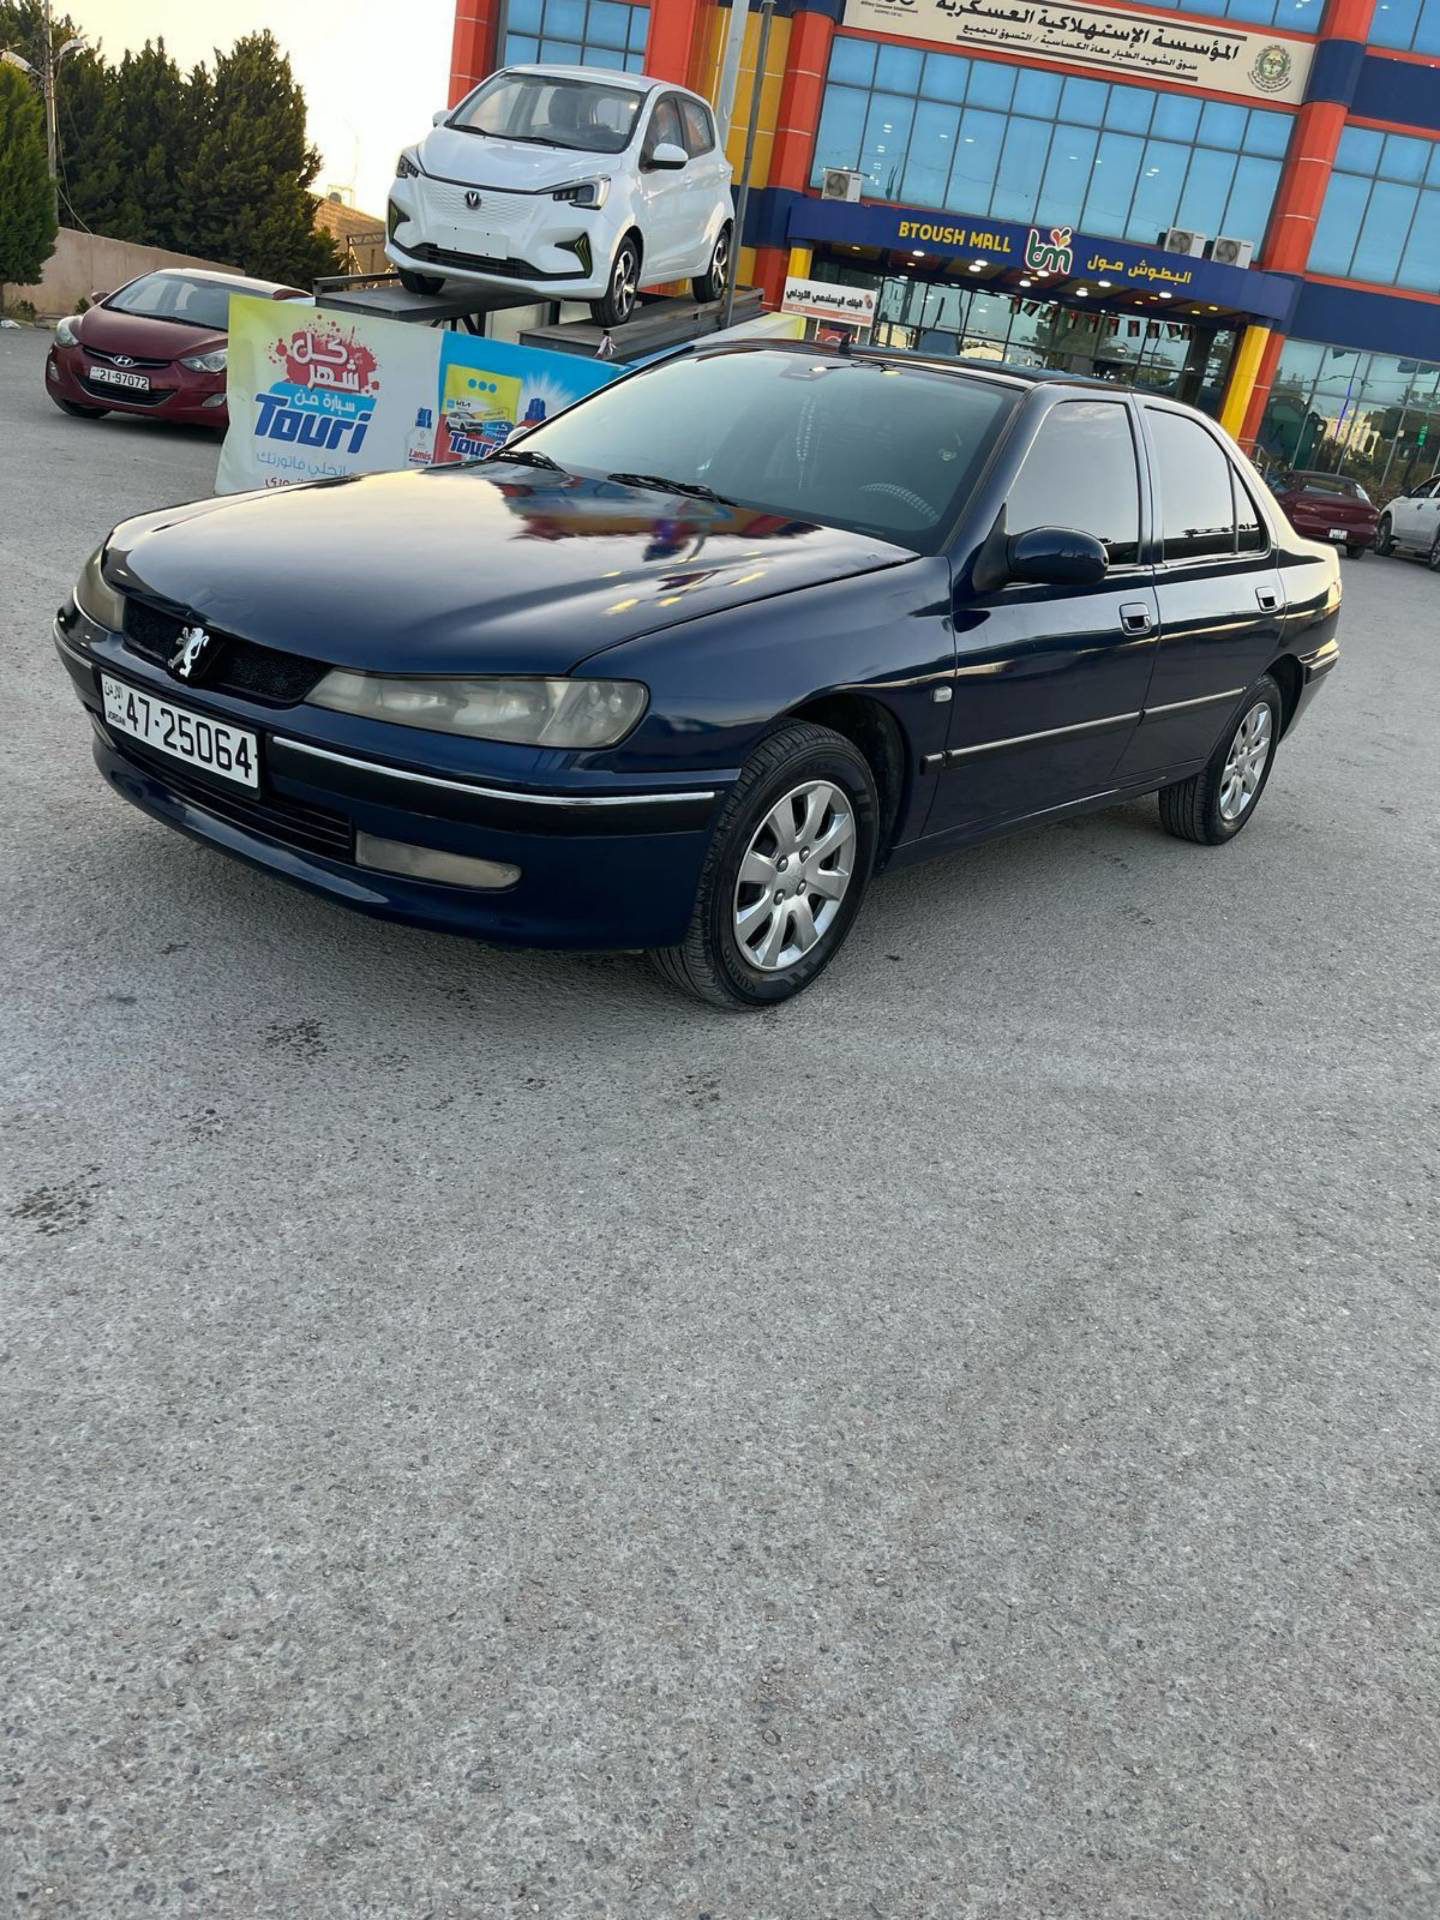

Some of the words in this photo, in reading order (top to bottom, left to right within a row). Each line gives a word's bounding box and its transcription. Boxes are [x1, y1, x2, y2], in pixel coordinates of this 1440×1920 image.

[936, 0, 1036, 23] العسكرية
[962, 23, 998, 38] للجميع
[998, 28, 1032, 41] التسوق
[1037, 9, 1150, 48] الإستهلاكية
[1152, 28, 1240, 61] المؤسسة
[1140, 53, 1176, 66] الشهيد
[1175, 59, 1198, 70] سوق
[899, 221, 966, 246] BTOUSH
[969, 233, 1012, 253] MALL
[1087, 254, 1124, 273] مول
[1128, 260, 1193, 286] البطوش
[292, 331, 349, 366] كل
[99, 369, 148, 389] 21-97072
[306, 359, 360, 392] شهر
[293, 389, 320, 406] من
[323, 393, 356, 415] سيارة
[254, 393, 372, 454] Touri
[449, 431, 500, 459] Tour
[126, 692, 253, 779] 47-25064
